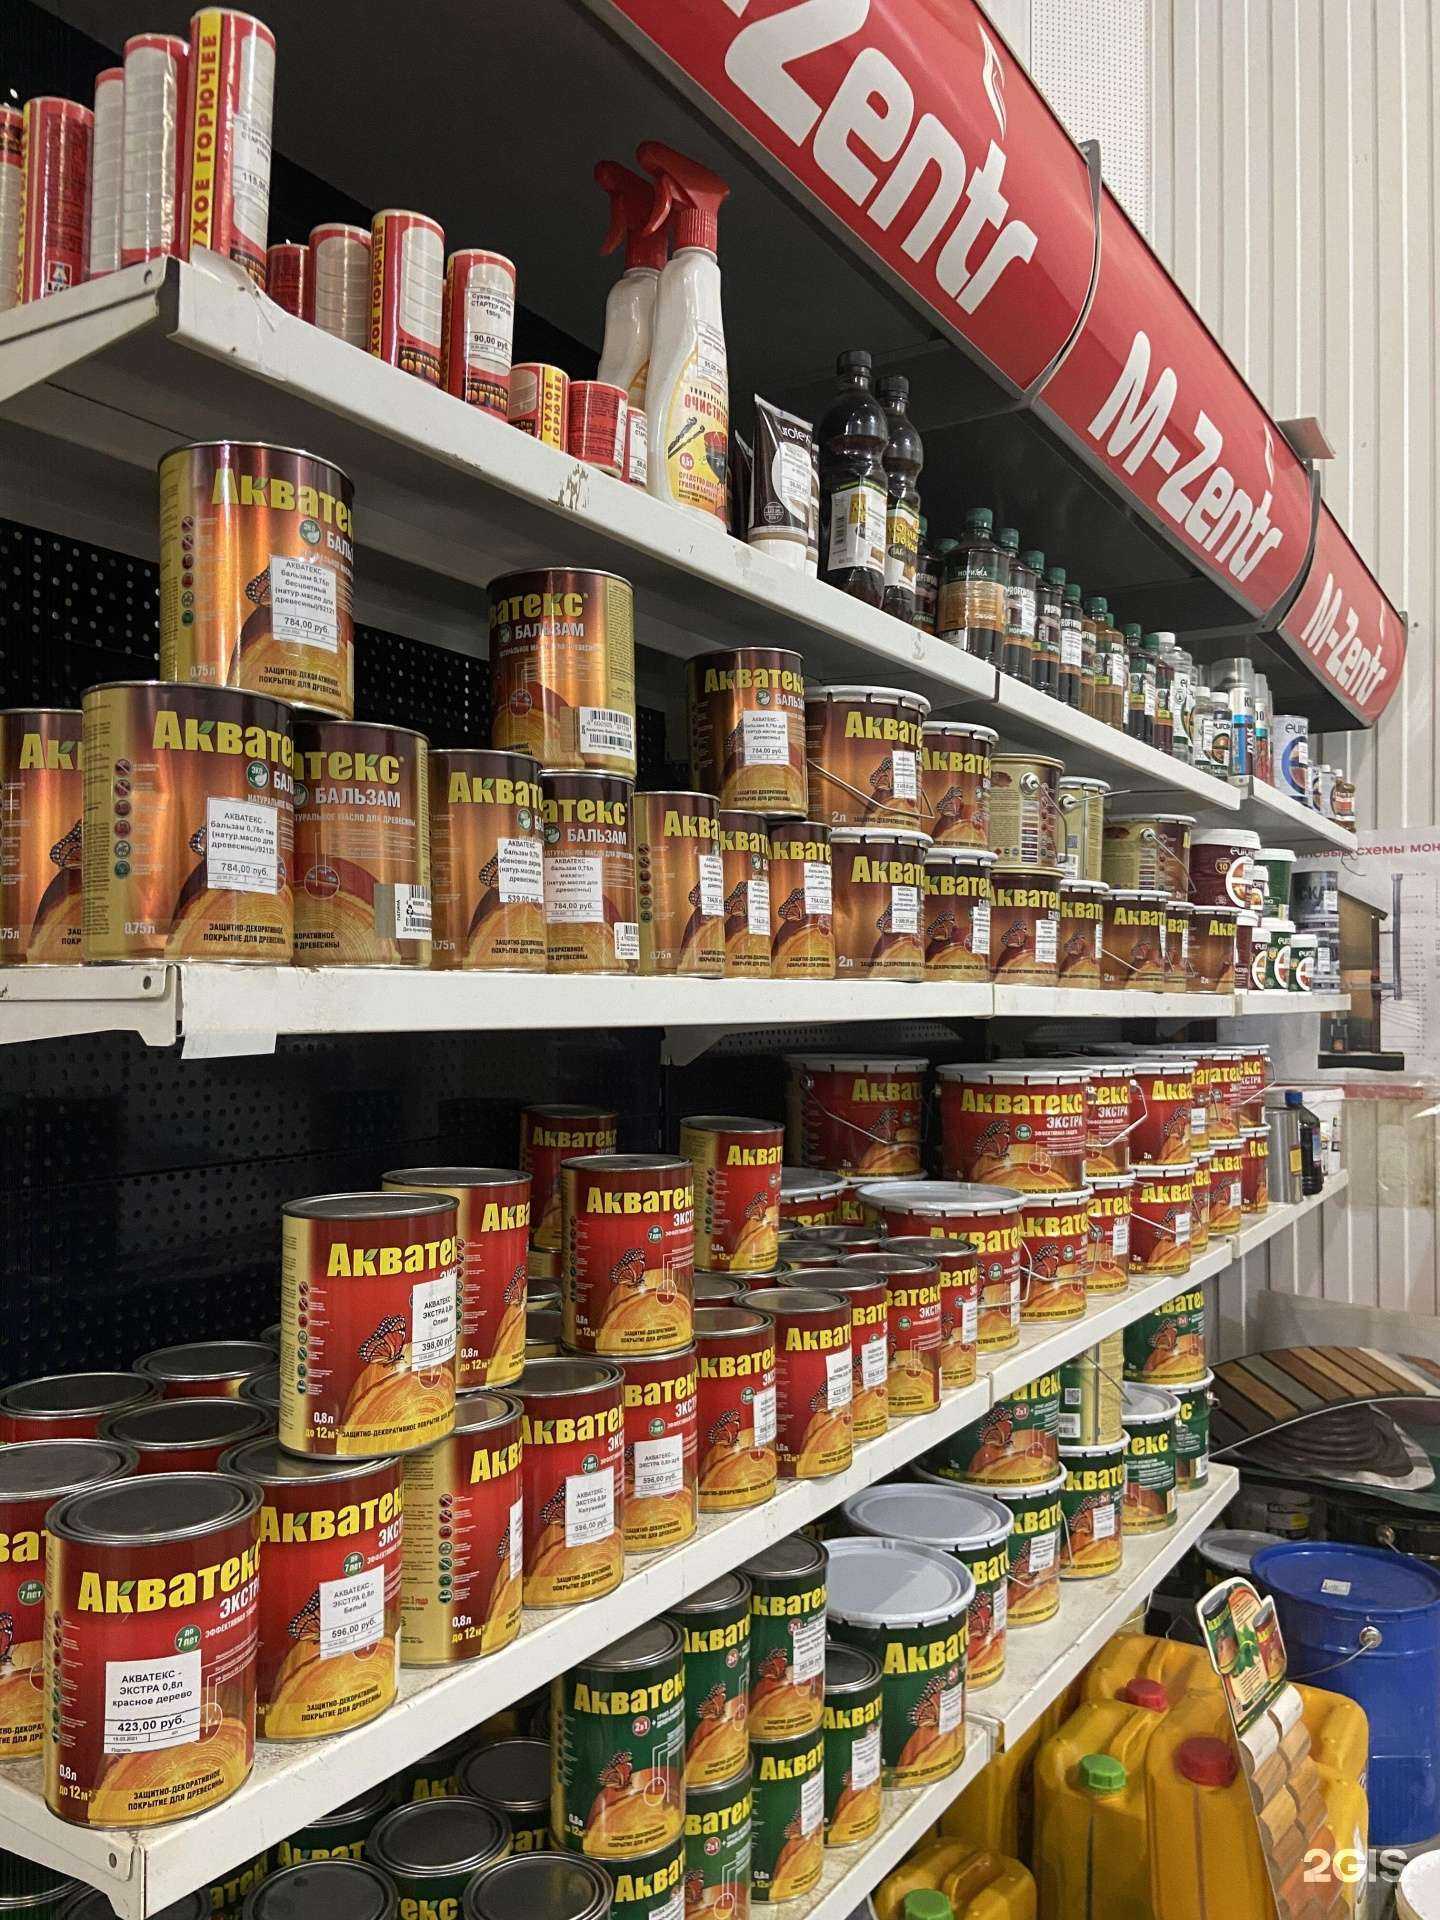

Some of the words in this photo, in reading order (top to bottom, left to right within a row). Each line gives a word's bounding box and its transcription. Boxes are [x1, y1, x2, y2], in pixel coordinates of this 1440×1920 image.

[196, 34, 218, 165] ГОРЮЧЕЕ
[720, 0, 1039, 315] Zentr
[473, 334, 496, 346] 90,00
[543, 380, 554, 432] СУХОЕ
[1087, 330, 1284, 583] M-Zentr
[284, 616, 313, 631] 784,00
[515, 622, 585, 640] БАЛЬЗАМ
[1300, 573, 1387, 706] M-Zentr
[315, 786, 401, 808] БАЛЬЗАМ
[224, 812, 263, 824] АКВАТЕКС
[831, 810, 847, 824] 2л
[567, 828, 627, 846] БАЛЬЗАМ
[1355, 845, 1405, 857] схемы
[221, 862, 252, 874] 784,00
[553, 902, 578, 910] 784,00
[838, 955, 854, 968] 2л
[961, 1088, 1083, 1115] Акватекс
[1098, 1104, 1128, 1118] ЭКСТРА
[1045, 1116, 1083, 1130] ЭКСТРА
[422, 1307, 445, 1320] ЭКСТРА
[422, 1338, 444, 1352] 398,00
[460, 1347, 479, 1359] 0,8л
[313, 1411, 334, 1425] 0,8л
[333, 1583, 371, 1599] АКВАТЕКС
[332, 1595, 360, 1609] ЭКСТРА
[451, 1613, 472, 1628] 0,8л
[183, 1635, 199, 1648] лет
[451, 1631, 463, 1643] до
[121, 1670, 176, 1684] АКВАТЕКС
[119, 1684, 160, 1696] ЭКСТРА
[162, 1680, 183, 1693] 0,8л
[112, 1697, 153, 1710] красное
[155, 1689, 193, 1706] дерево
[117, 1719, 157, 1734] 423,00
[160, 1714, 186, 1730] руб.
[11, 1733, 28, 1744] ДЛЯ
[59, 1763, 77, 1781] 0,8л
[133, 1768, 221, 1800] ЗАЩИТНО-ДЕКОРАТИВНОЕ
[127, 1795, 169, 1811] ПОКРЫТИЕ
[169, 1792, 185, 1806] ДЛЯ
[186, 1777, 225, 1802] ДРЕВЕСИНЫ
